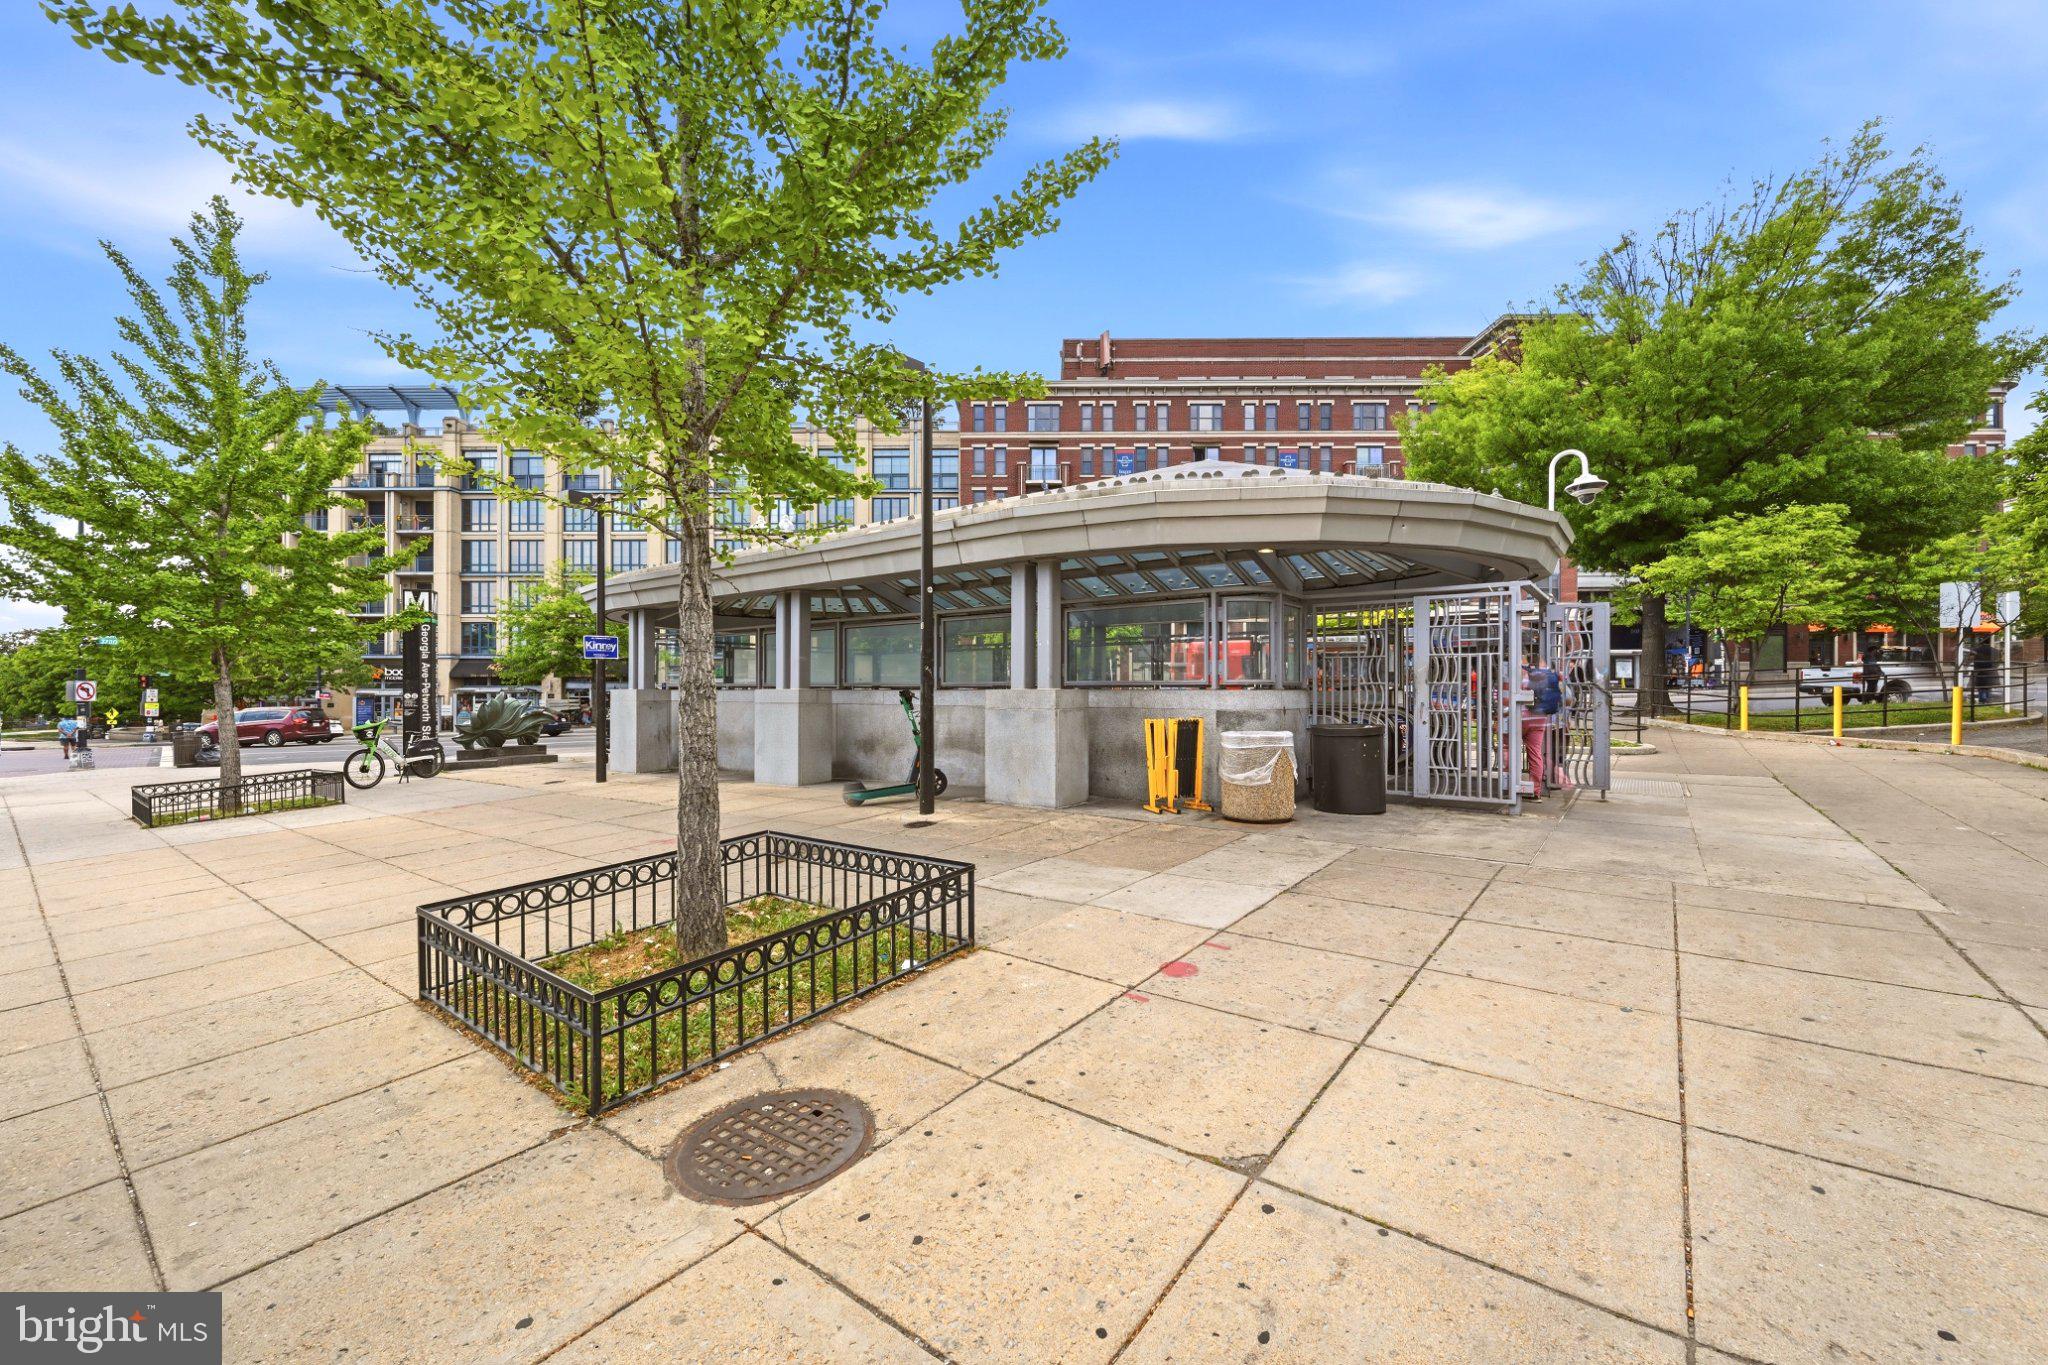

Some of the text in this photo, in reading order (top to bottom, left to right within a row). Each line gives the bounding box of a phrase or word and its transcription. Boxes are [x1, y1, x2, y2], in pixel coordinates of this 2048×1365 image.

[404, 590, 429, 612] M
[384, 667, 403, 676] boo
[420, 624, 432, 741] Georgia Ave-Petworth Sta
